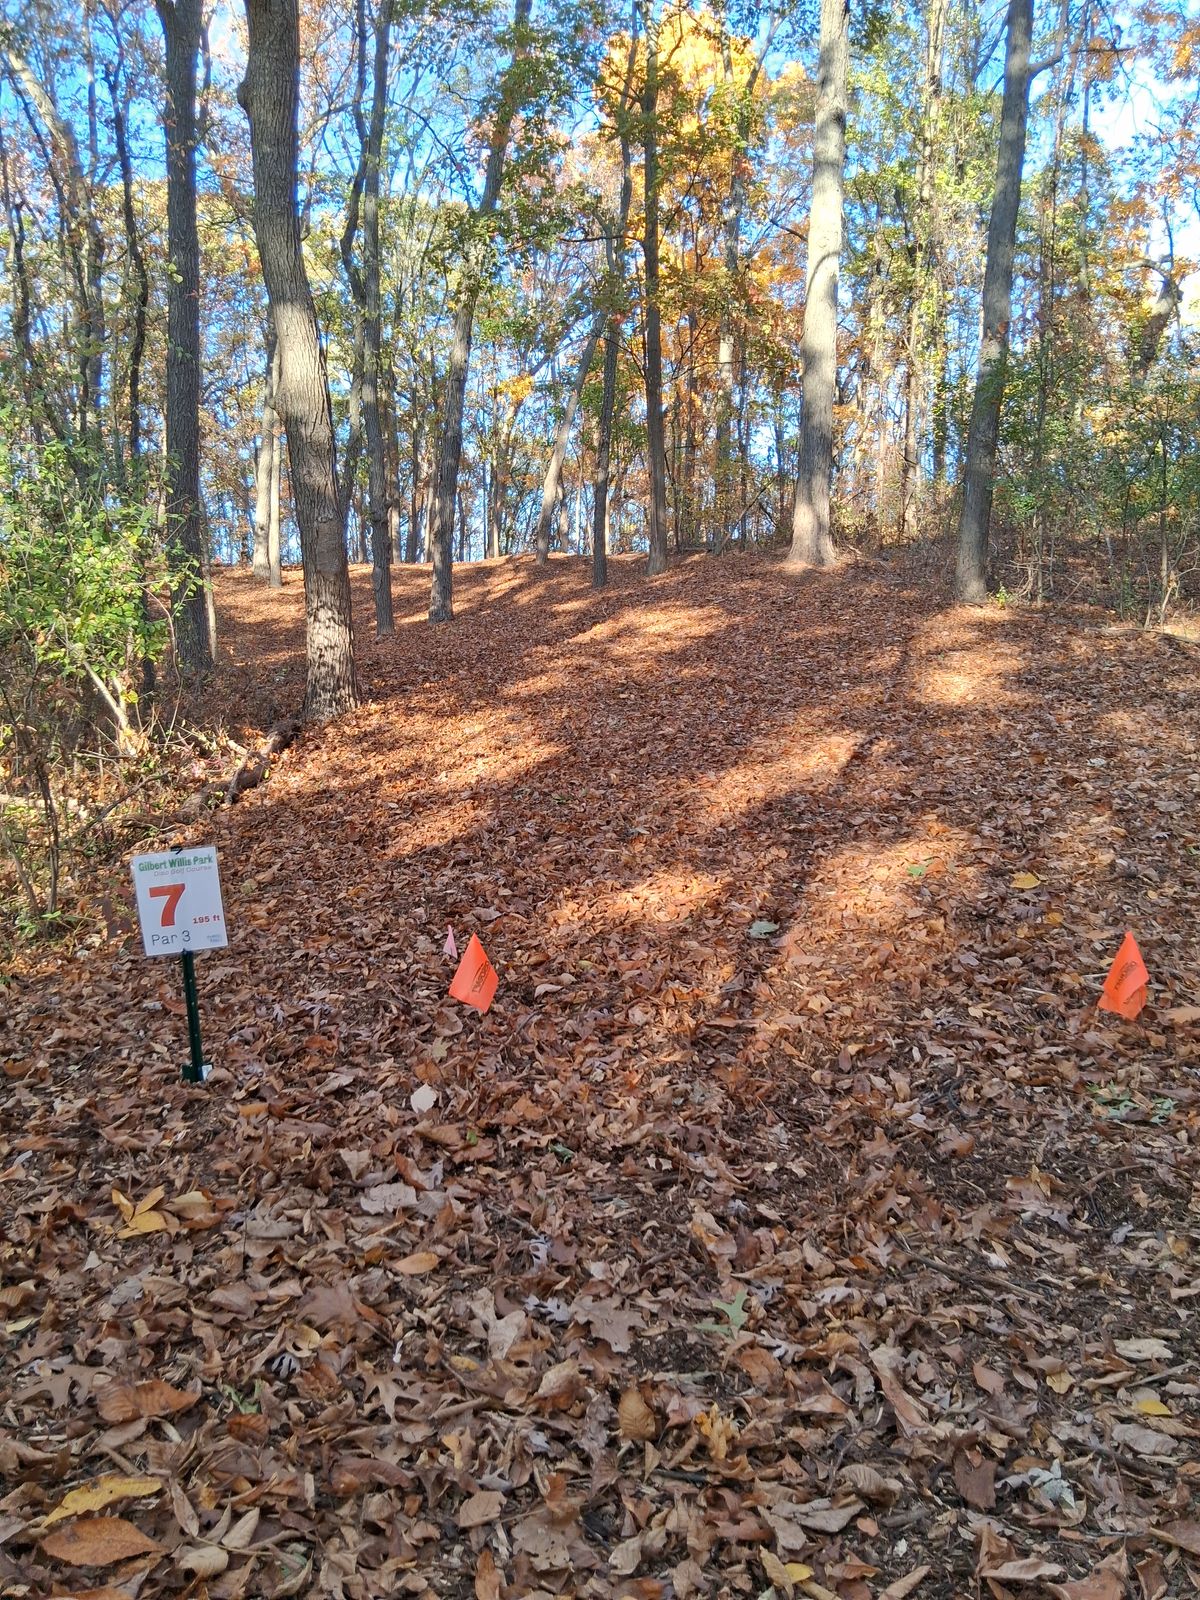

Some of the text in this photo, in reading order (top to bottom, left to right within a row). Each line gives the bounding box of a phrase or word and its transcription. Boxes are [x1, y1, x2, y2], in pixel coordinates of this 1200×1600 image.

[138, 855, 213, 872] Gilbert Willis Park
[149, 883, 186, 927] 7
[193, 916, 210, 924] 195
[151, 930, 191, 946] Par 3
